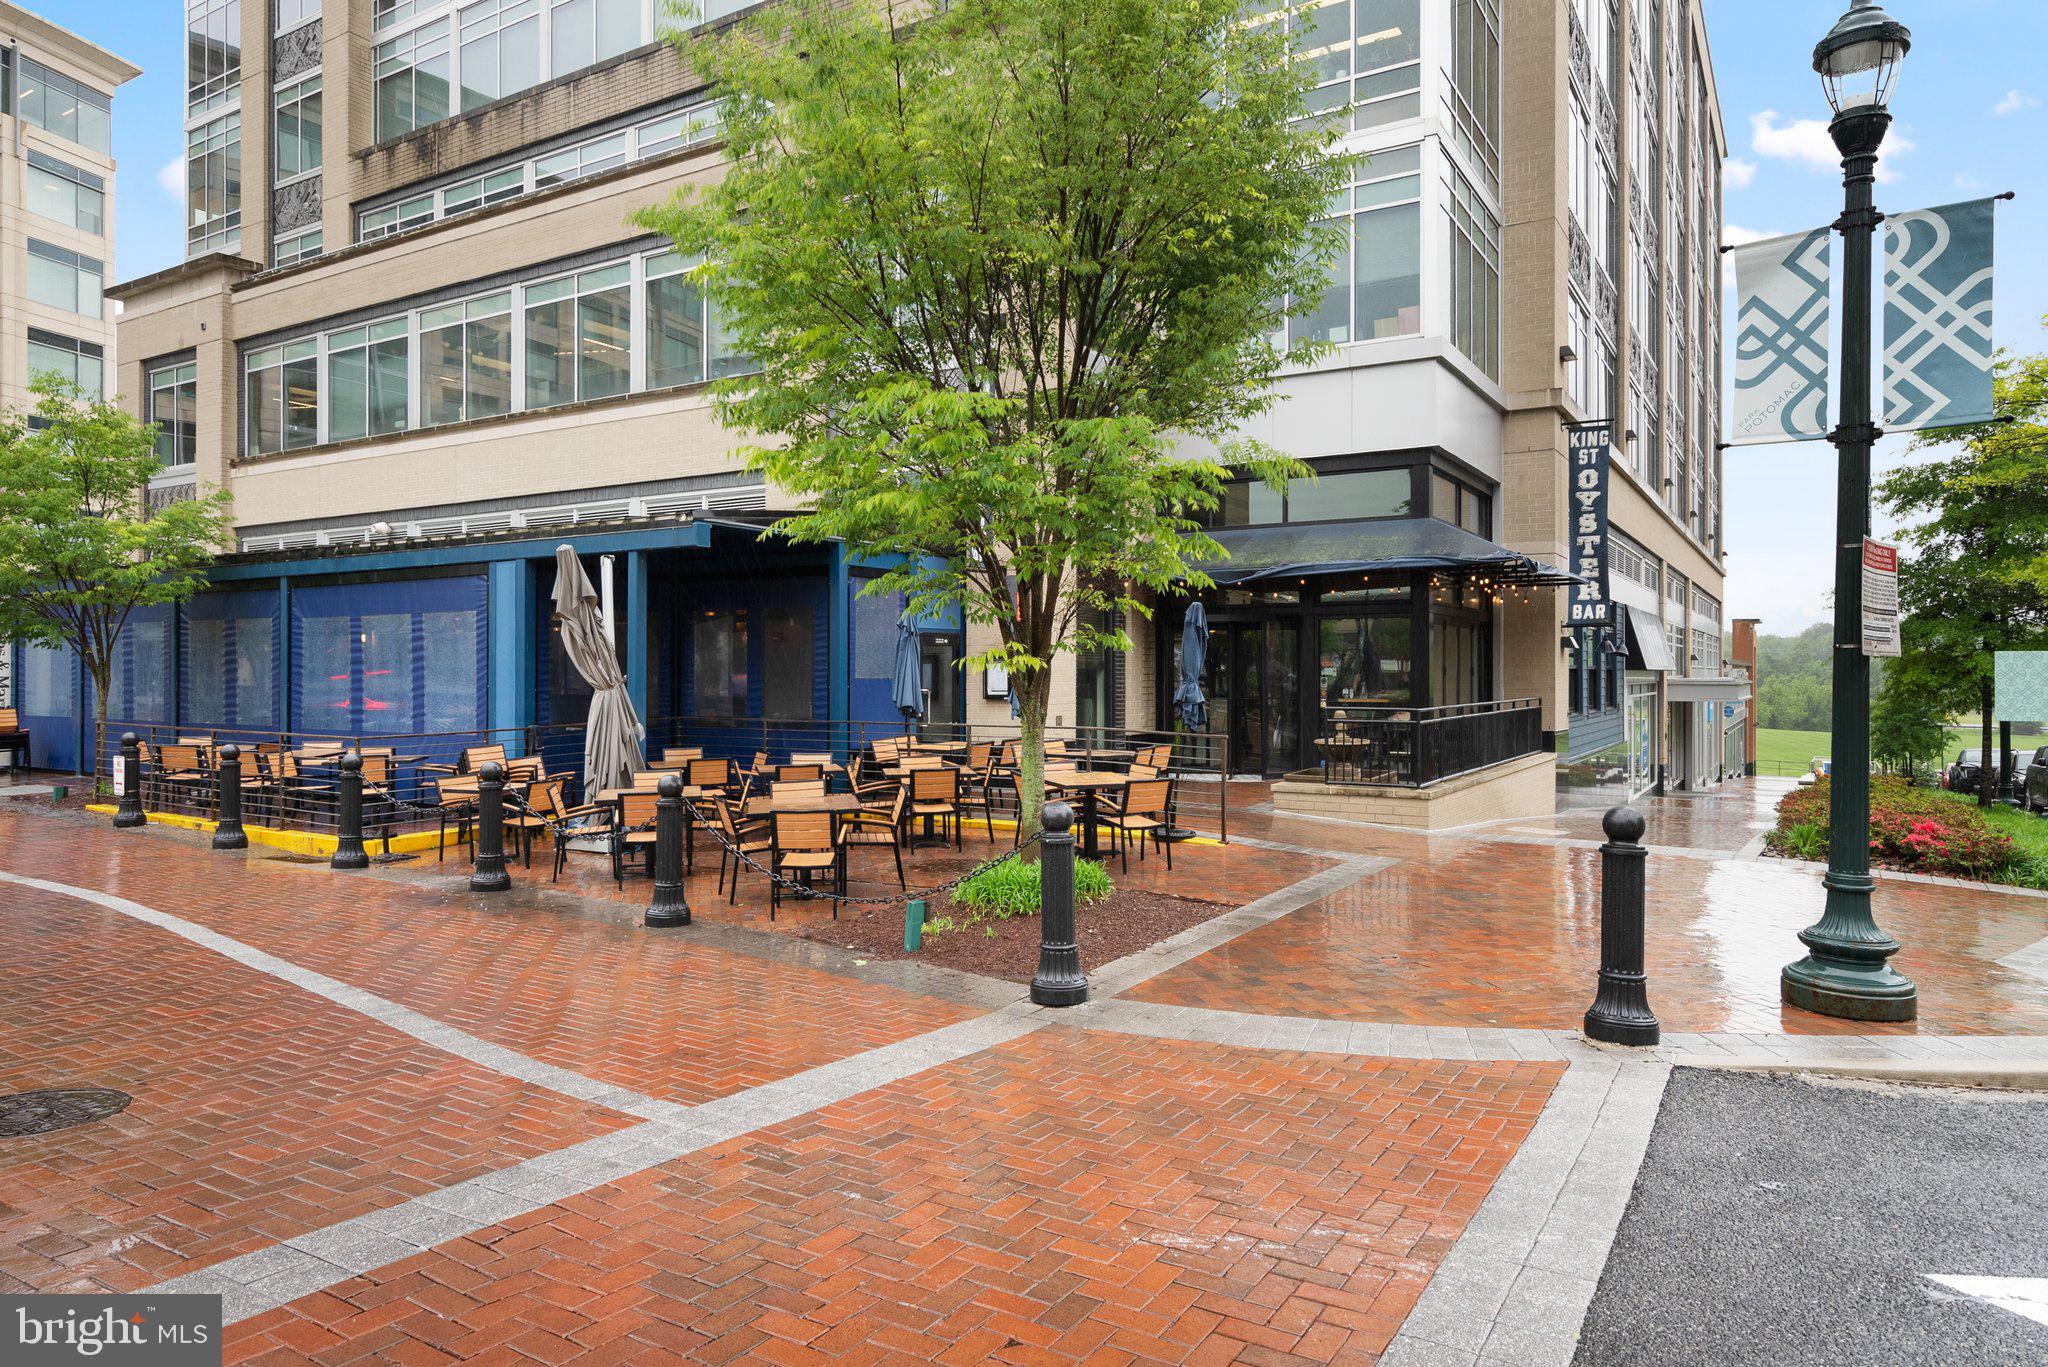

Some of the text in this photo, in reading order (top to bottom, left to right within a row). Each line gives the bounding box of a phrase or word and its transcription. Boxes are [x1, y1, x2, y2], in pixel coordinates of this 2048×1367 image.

[1744, 381, 1801, 434] POTOMAC
[1738, 408, 1760, 428] PARK
[1570, 431, 1609, 448] KING
[1578, 449, 1600, 465] ST
[1575, 468, 1601, 601] OYSTER
[1572, 604, 1606, 620] BAR
